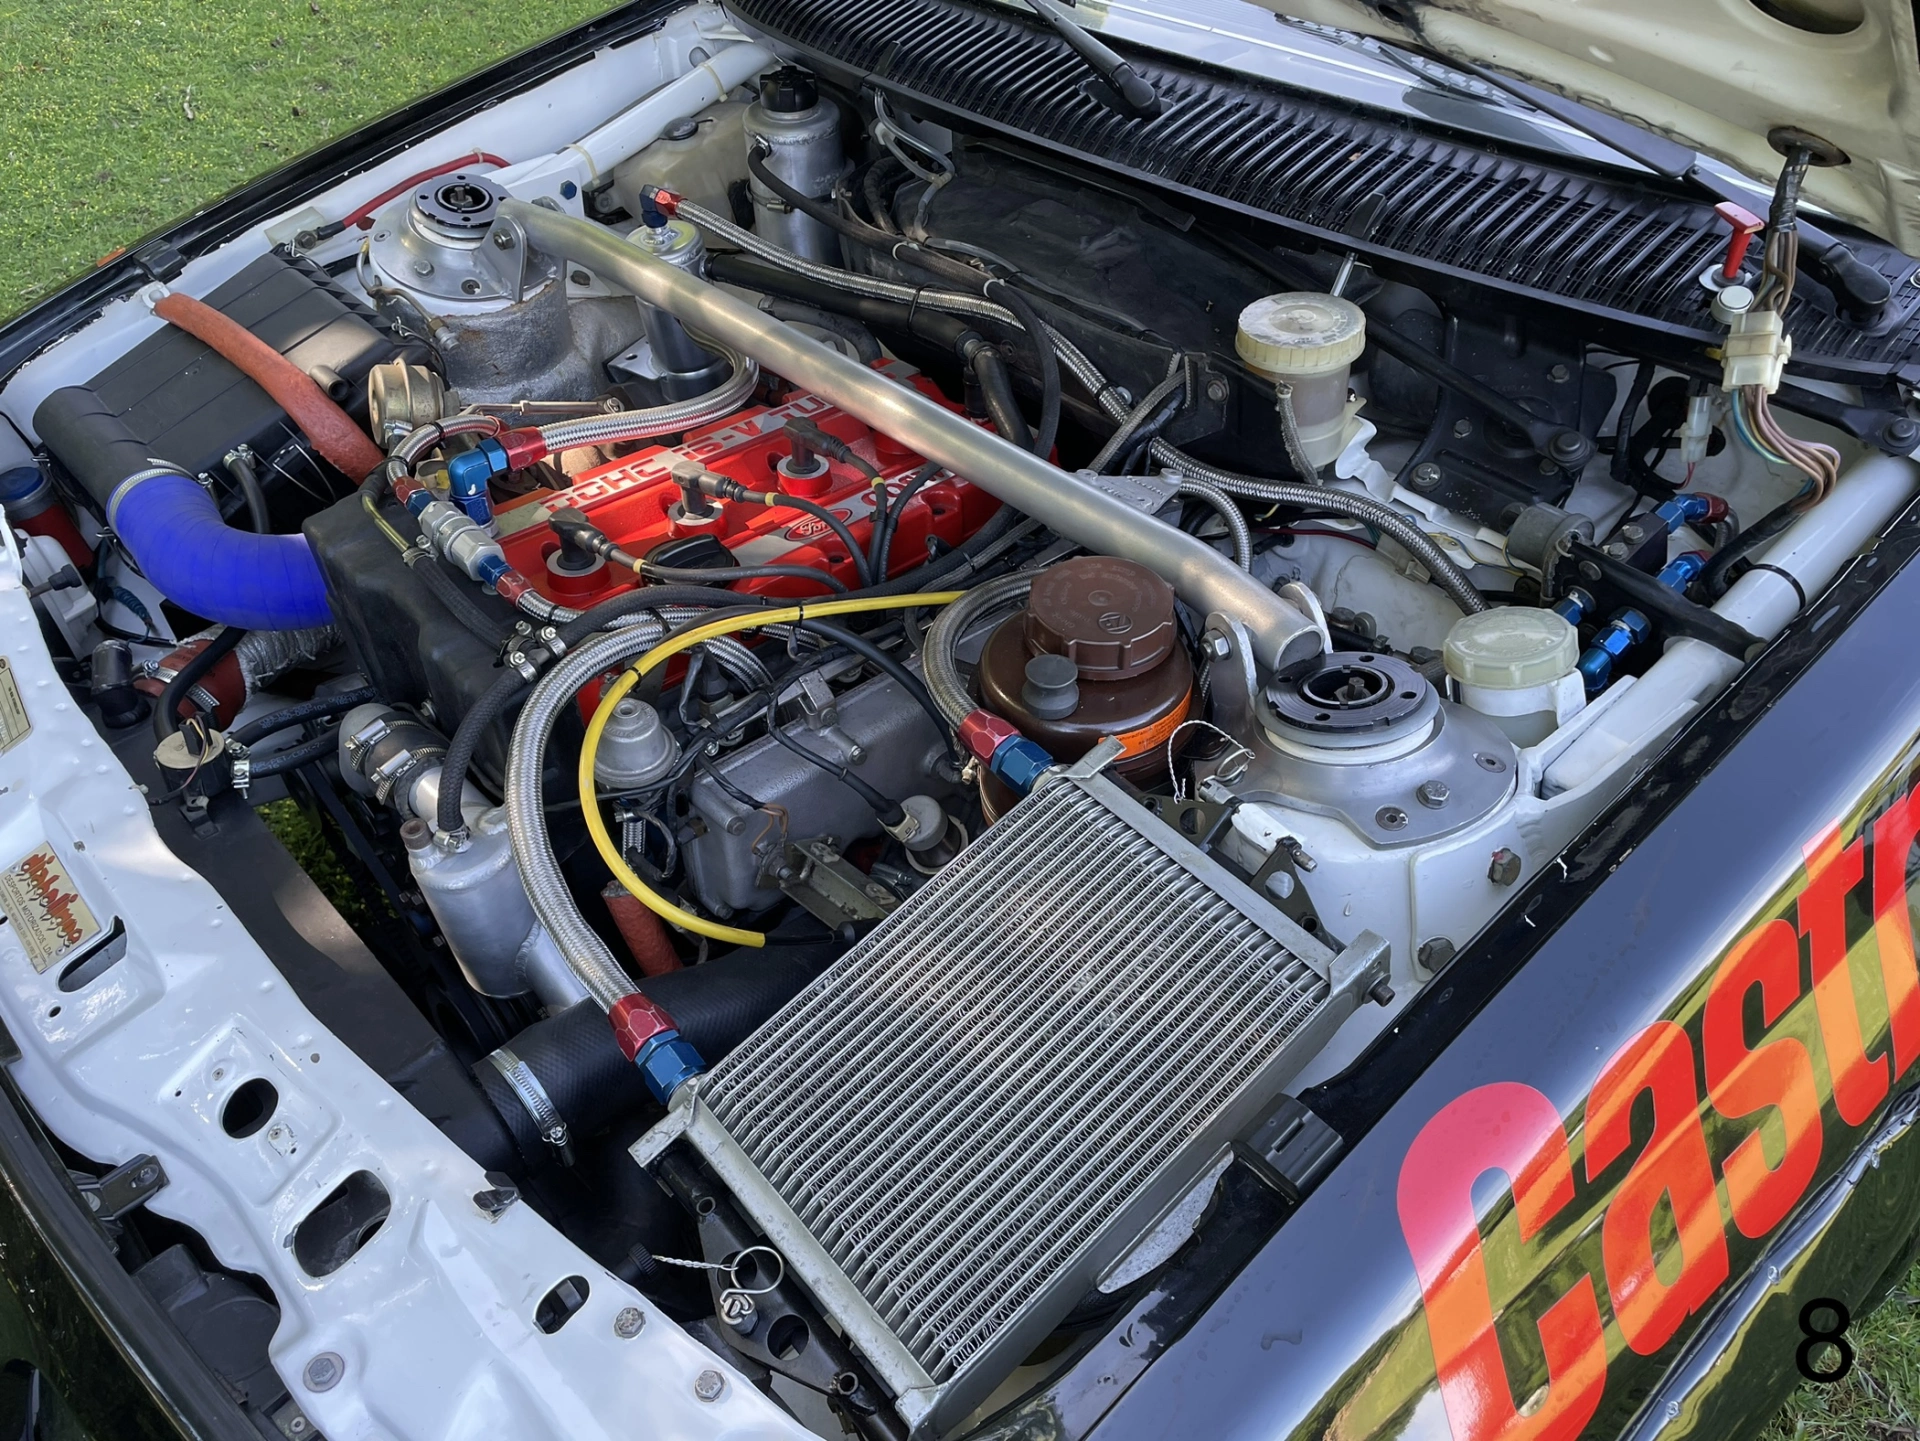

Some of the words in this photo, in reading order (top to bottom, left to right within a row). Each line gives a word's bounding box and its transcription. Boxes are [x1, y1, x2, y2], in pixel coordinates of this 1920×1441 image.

[540, 458, 668, 511] DOHC
[671, 420, 764, 460] 16-V
[4, 874, 26, 906] DESPORTOS
